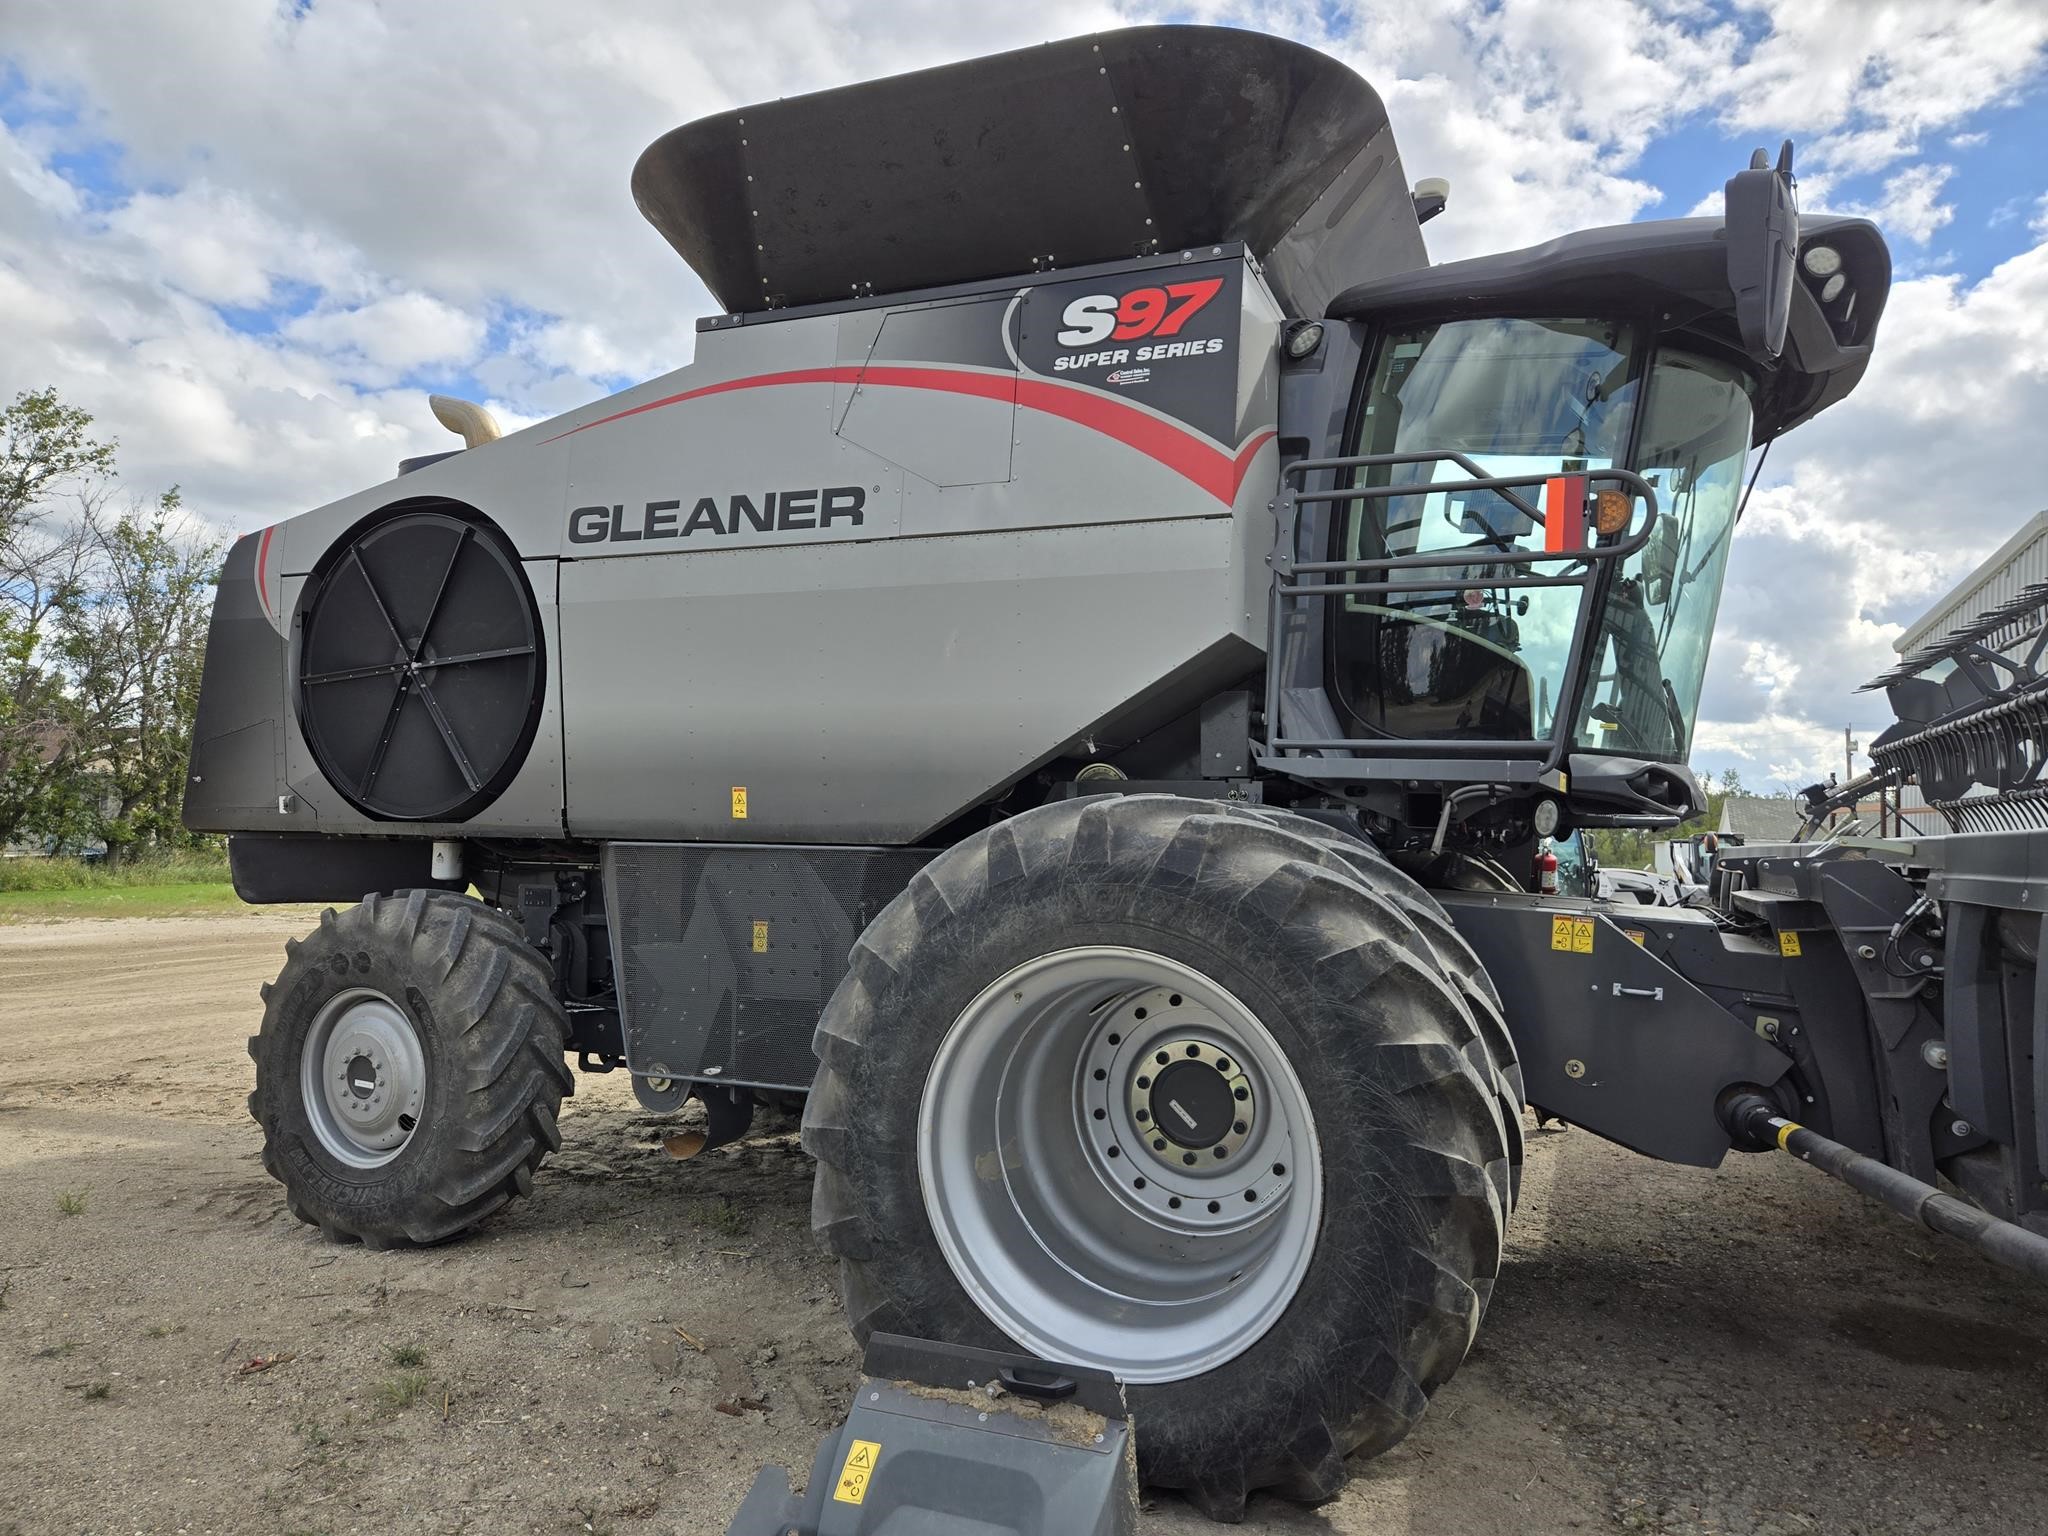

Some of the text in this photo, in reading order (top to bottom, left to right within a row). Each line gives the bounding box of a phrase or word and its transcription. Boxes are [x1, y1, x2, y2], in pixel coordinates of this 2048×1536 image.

[1057, 278, 1224, 347] S97
[1054, 338, 1224, 371] SUPER SERIES
[568, 486, 866, 544] GLEANER
